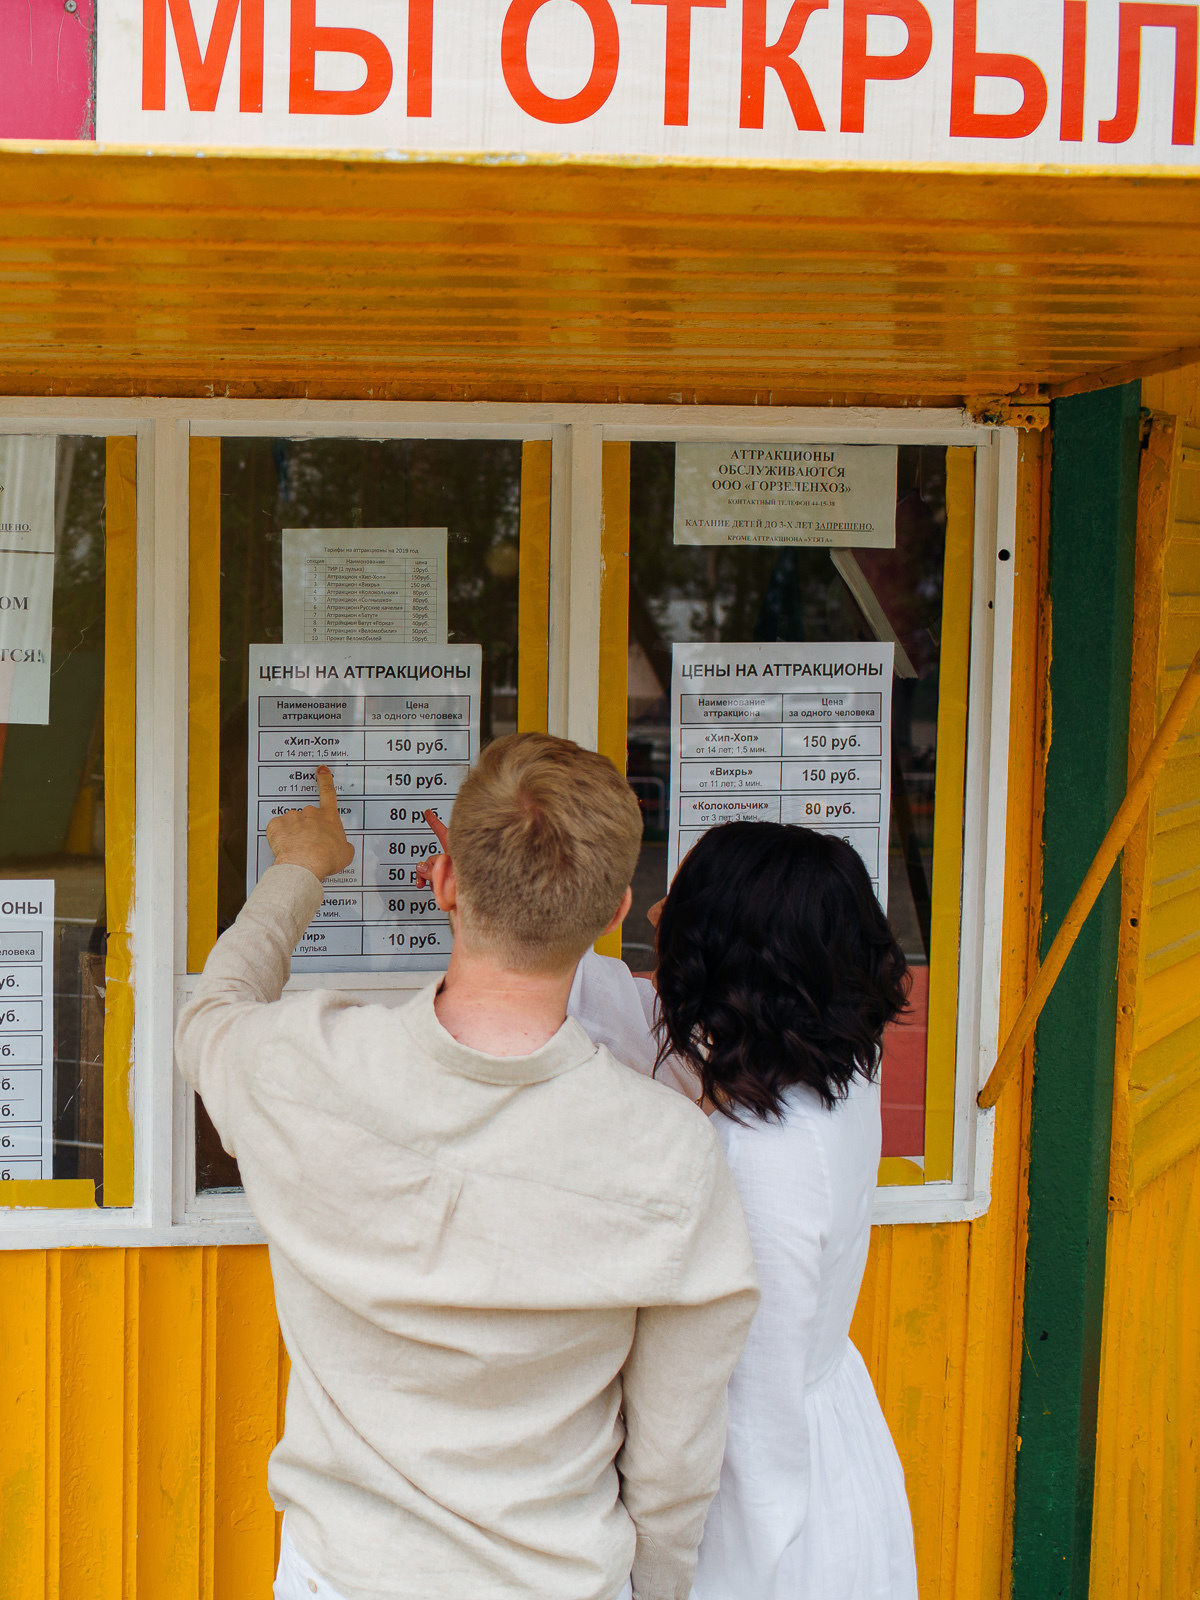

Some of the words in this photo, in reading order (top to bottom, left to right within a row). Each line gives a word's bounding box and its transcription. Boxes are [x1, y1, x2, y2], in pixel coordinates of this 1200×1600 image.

[142, 0, 433, 118] МЫ
[501, 0, 1199, 146] ОТКРЫЛ
[731, 450, 834, 462] АТТРАКЦИОНЫ
[718, 464, 845, 478] ОБСЛУЖИВАЮТСЯ
[712, 480, 741, 490] ООО
[744, 480, 851, 493] «ГОРЗЕЛЕНХОЗ»
[685, 520, 730, 528] КАТАНИЕ
[732, 519, 762, 528] ДЕТЕЙ
[260, 666, 309, 681] ЦЕНЫ
[316, 666, 339, 679] НА
[344, 666, 470, 681] АТТРАКЦИОНЫ
[682, 664, 730, 679] ЦЕНЫ
[736, 664, 758, 676] НА
[762, 663, 882, 678] АТТРАКЦИОНЫ
[277, 701, 347, 709] Наименование
[404, 700, 429, 710] Цена
[698, 697, 765, 707] Наименование
[820, 697, 844, 708] Цена
[282, 711, 343, 720] аттракциона
[384, 712, 417, 721] одного
[420, 712, 462, 720] человека
[702, 708, 761, 719] аттракциона
[801, 710, 832, 718] одного
[835, 709, 875, 717] человека
[284, 736, 340, 745] «Хип-Хоп»
[705, 733, 758, 743] «Хип-Хоп»
[804, 736, 826, 747] 150
[832, 735, 860, 750] руб.
[387, 739, 411, 751] 150
[417, 739, 447, 754] руб.
[710, 767, 752, 778] «Вихрь»
[803, 769, 826, 781] 150
[831, 768, 860, 784] руб.
[387, 774, 411, 786] 150
[416, 773, 447, 789] руб.
[692, 801, 768, 811] «Колокольчик»
[805, 803, 820, 815] 80
[826, 802, 855, 817] руб.
[390, 808, 406, 820] 80
[388, 842, 406, 854] 80
[411, 842, 442, 858] руб.
[388, 868, 405, 881] 50
[388, 899, 405, 911] 80
[410, 899, 440, 913] руб.
[389, 934, 405, 946] 10
[410, 933, 440, 947] руб.
[300, 946, 328, 954] пулька
